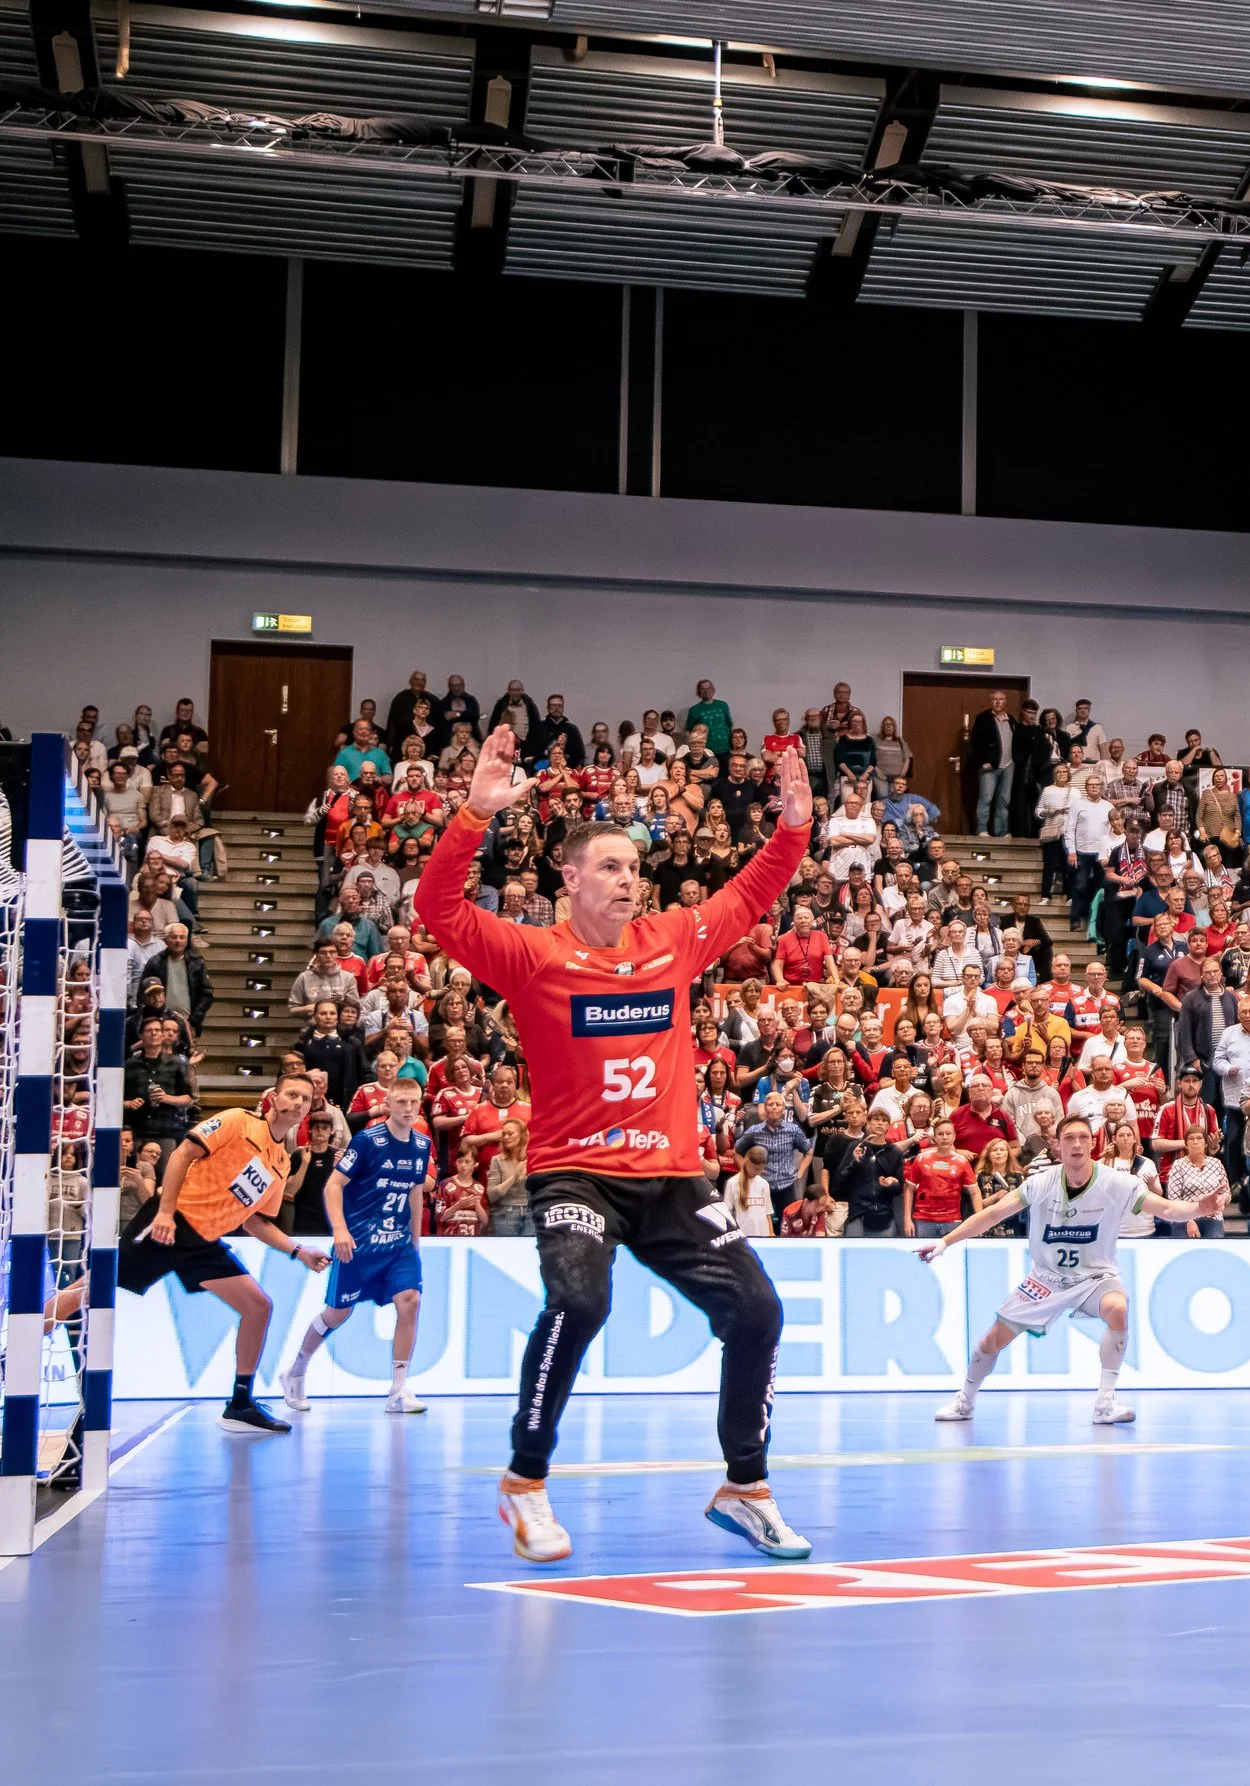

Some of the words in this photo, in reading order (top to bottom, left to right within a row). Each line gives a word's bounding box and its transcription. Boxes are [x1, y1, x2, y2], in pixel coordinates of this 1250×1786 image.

[585, 1003, 670, 1022] Buderus
[601, 1056, 656, 1102] 52
[382, 1192, 408, 1213] 21
[1056, 1248, 1080, 1268] 25
[539, 1344, 555, 1373] Spiel
[535, 1372, 549, 1392] das
[532, 1392, 544, 1408] du
